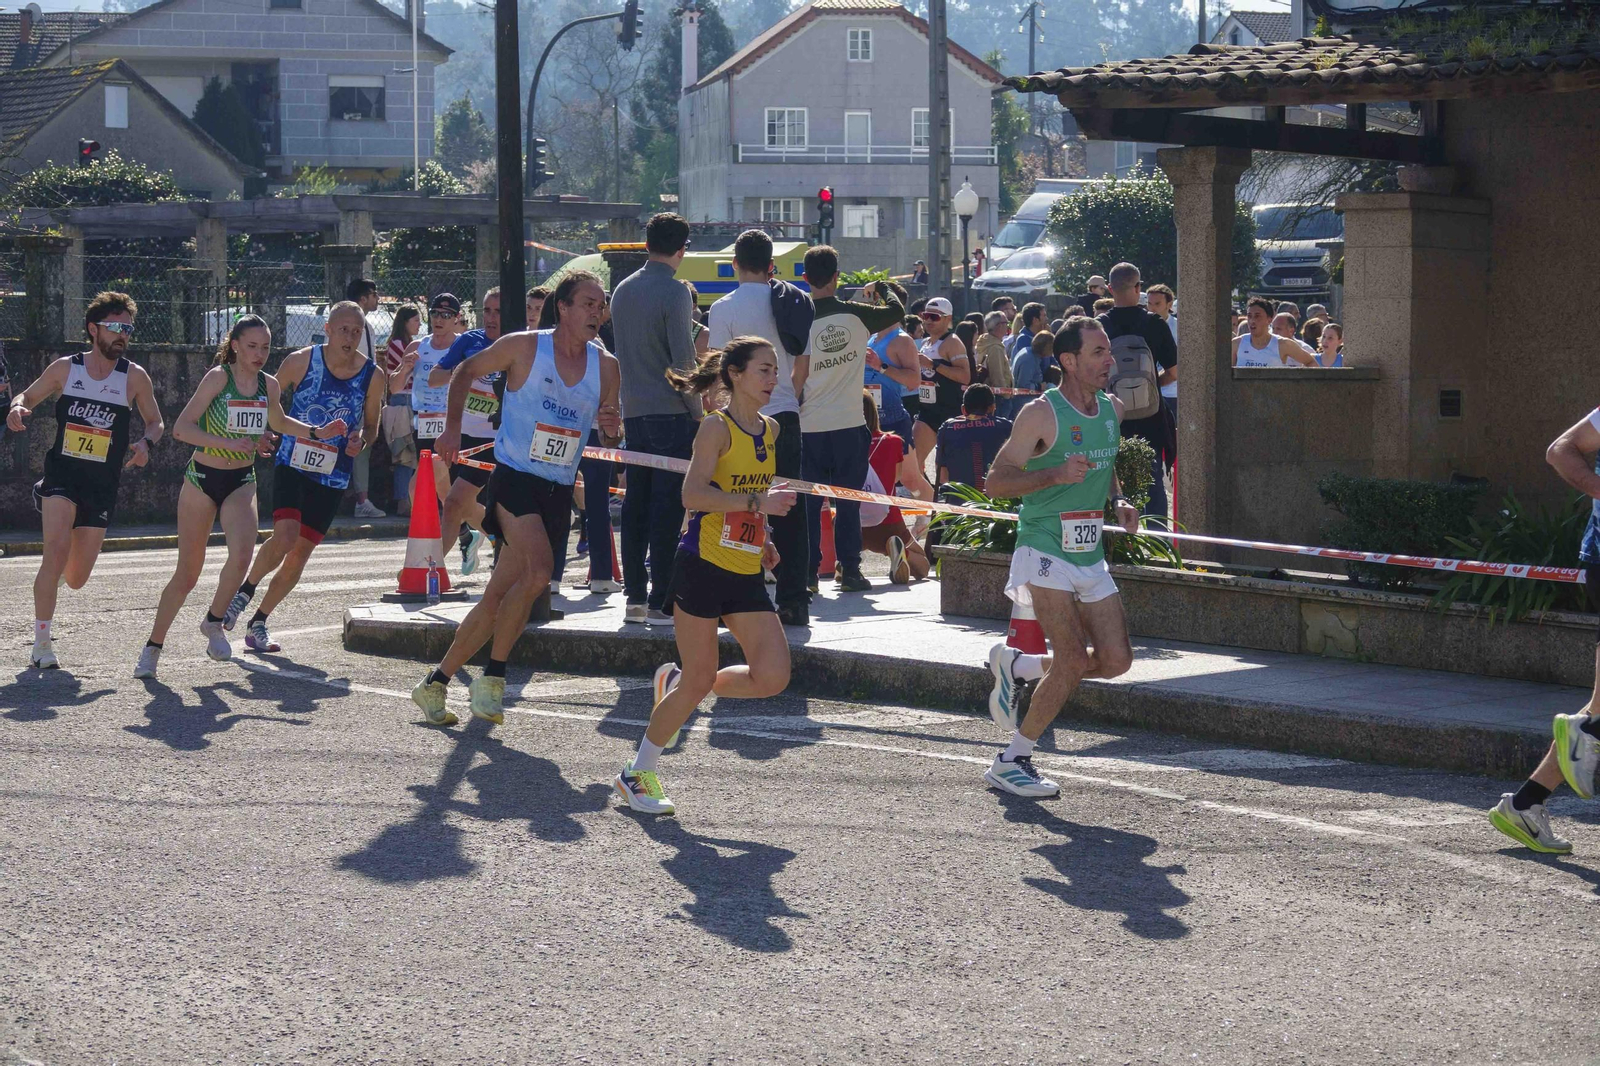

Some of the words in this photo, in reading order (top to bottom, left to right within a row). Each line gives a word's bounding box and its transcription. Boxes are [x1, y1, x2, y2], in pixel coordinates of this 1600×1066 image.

[820, 330, 846, 342] Estrella
[822, 337, 846, 348] Galicia
[321, 390, 352, 404] RUNNERS
[467, 397, 495, 414] 2227
[68, 401, 117, 424] delikia
[236, 411, 263, 428] 1078
[92, 419, 107, 428] fresh
[425, 421, 444, 434] 276
[953, 420, 974, 431] Red
[974, 419, 996, 428] Bull
[78, 436, 94, 454] 74
[545, 438, 568, 458] 521
[303, 450, 326, 468] 162
[739, 522, 756, 544] 20
[1074, 525, 1097, 544] 328
